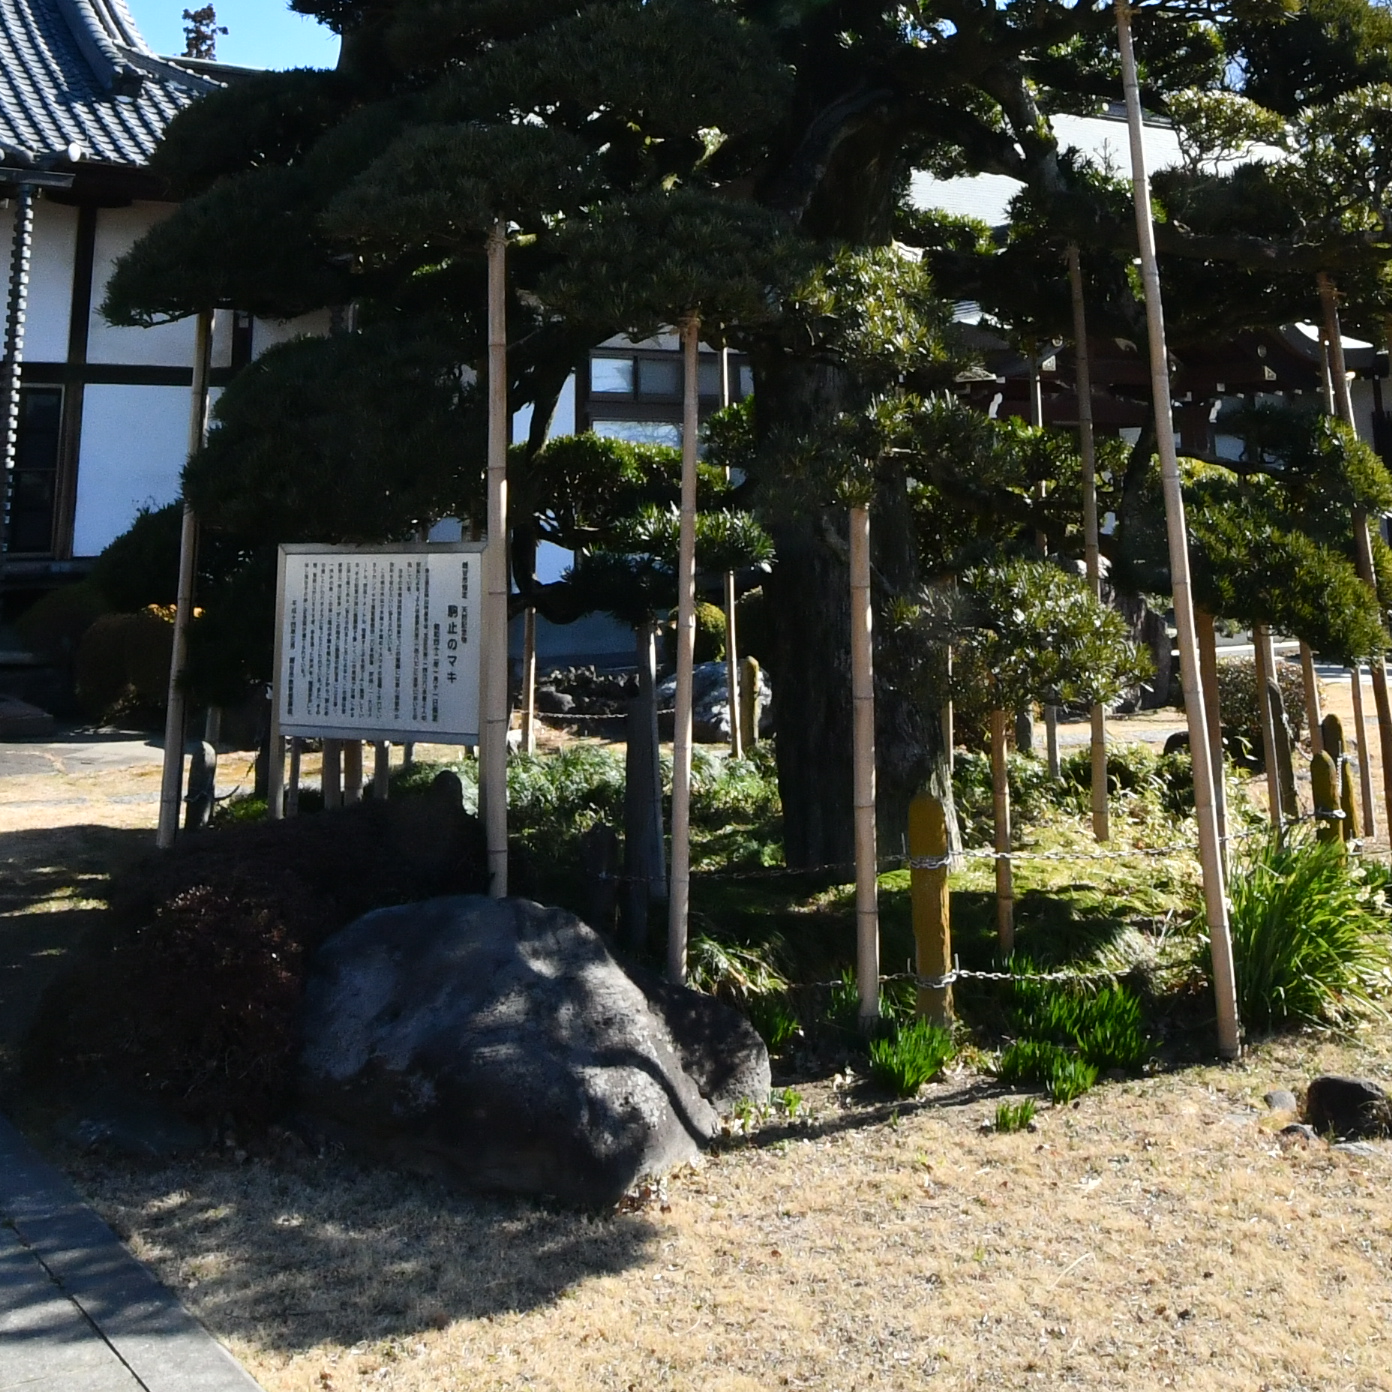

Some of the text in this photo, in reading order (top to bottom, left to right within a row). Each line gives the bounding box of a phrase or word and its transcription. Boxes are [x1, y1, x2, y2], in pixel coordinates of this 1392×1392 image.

[446, 604, 459, 684] 駒止のマキ
